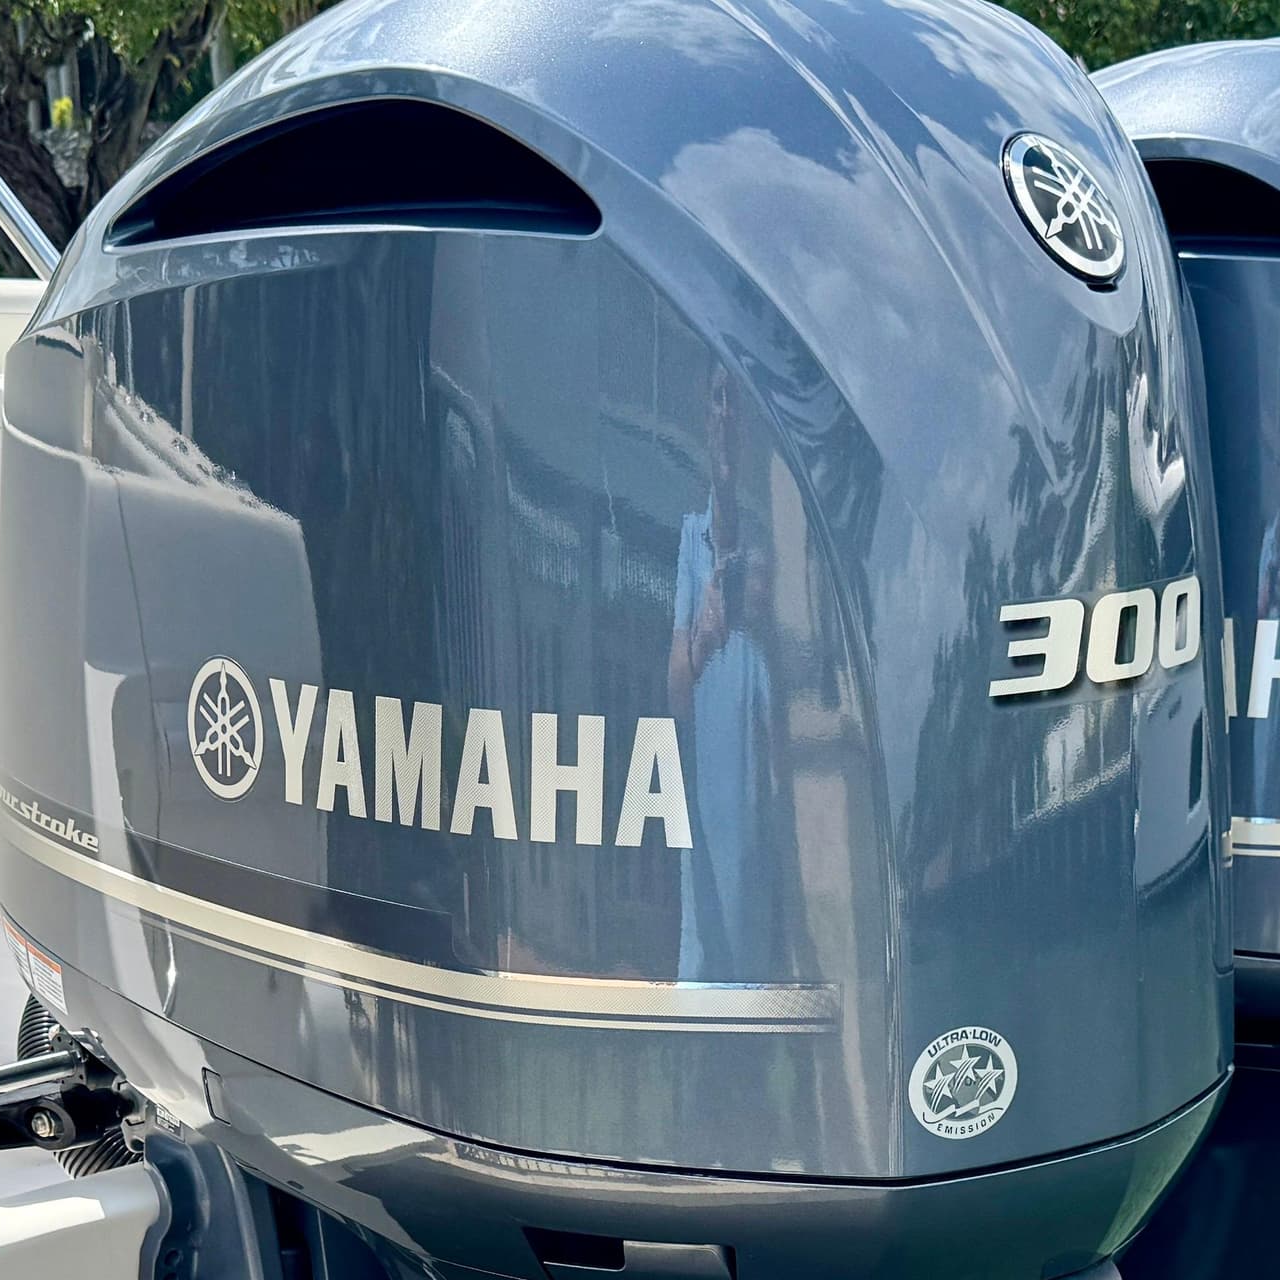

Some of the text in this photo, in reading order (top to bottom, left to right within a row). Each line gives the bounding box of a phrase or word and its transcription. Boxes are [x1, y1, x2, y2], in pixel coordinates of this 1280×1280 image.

[988, 574, 1201, 697] 300
[268, 677, 693, 850] YAMAHA
[936, 1112, 996, 1136] EMISSION
